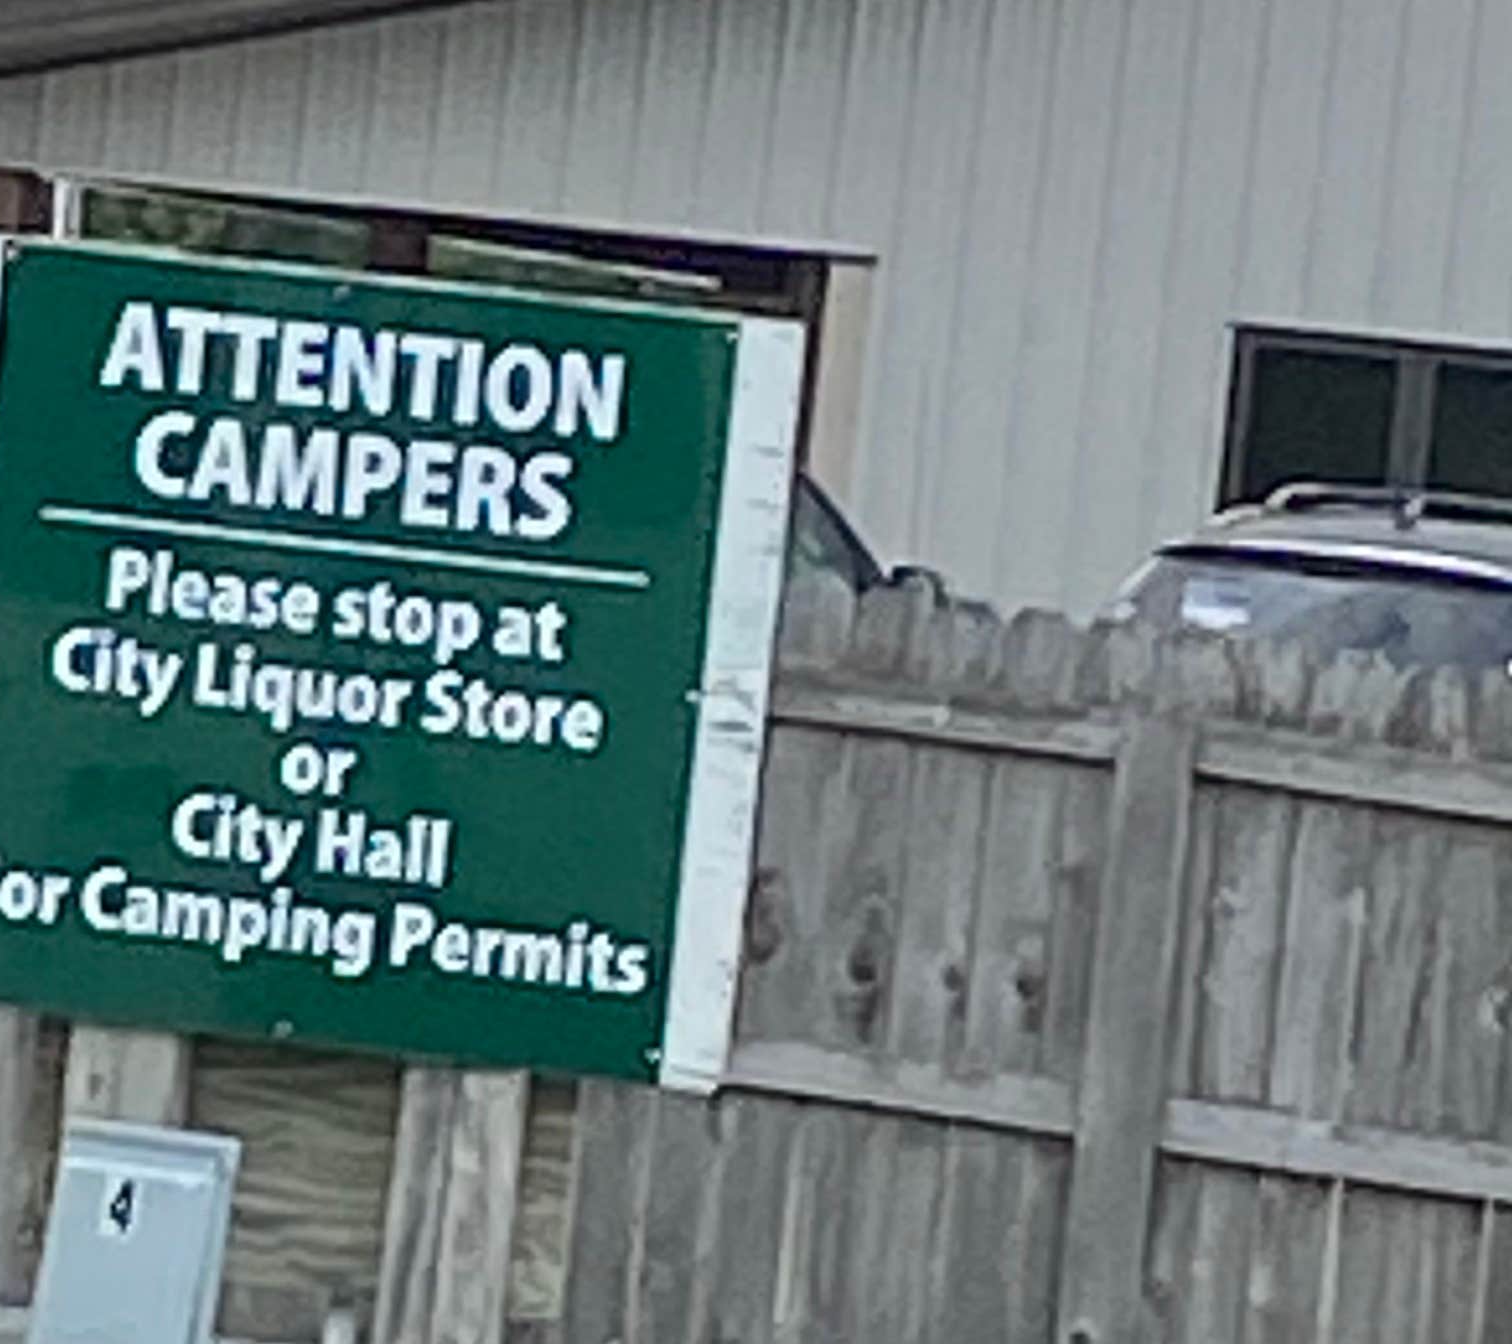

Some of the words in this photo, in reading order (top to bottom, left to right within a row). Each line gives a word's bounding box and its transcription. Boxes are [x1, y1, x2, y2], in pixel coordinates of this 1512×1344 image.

[99, 300, 627, 443] ATTENTION
[134, 411, 575, 540] CAMPERS
[105, 549, 320, 635] Please
[333, 579, 480, 662] stop
[494, 605, 567, 660] at
[51, 627, 182, 717] City
[194, 644, 413, 734] Liquor
[423, 672, 603, 750] Store
[281, 743, 356, 797] or
[171, 794, 303, 887] City
[317, 809, 452, 887] Hall
[80, 867, 375, 975] Camping
[389, 905, 651, 996] Permits
[110, 1178, 133, 1234] 4
